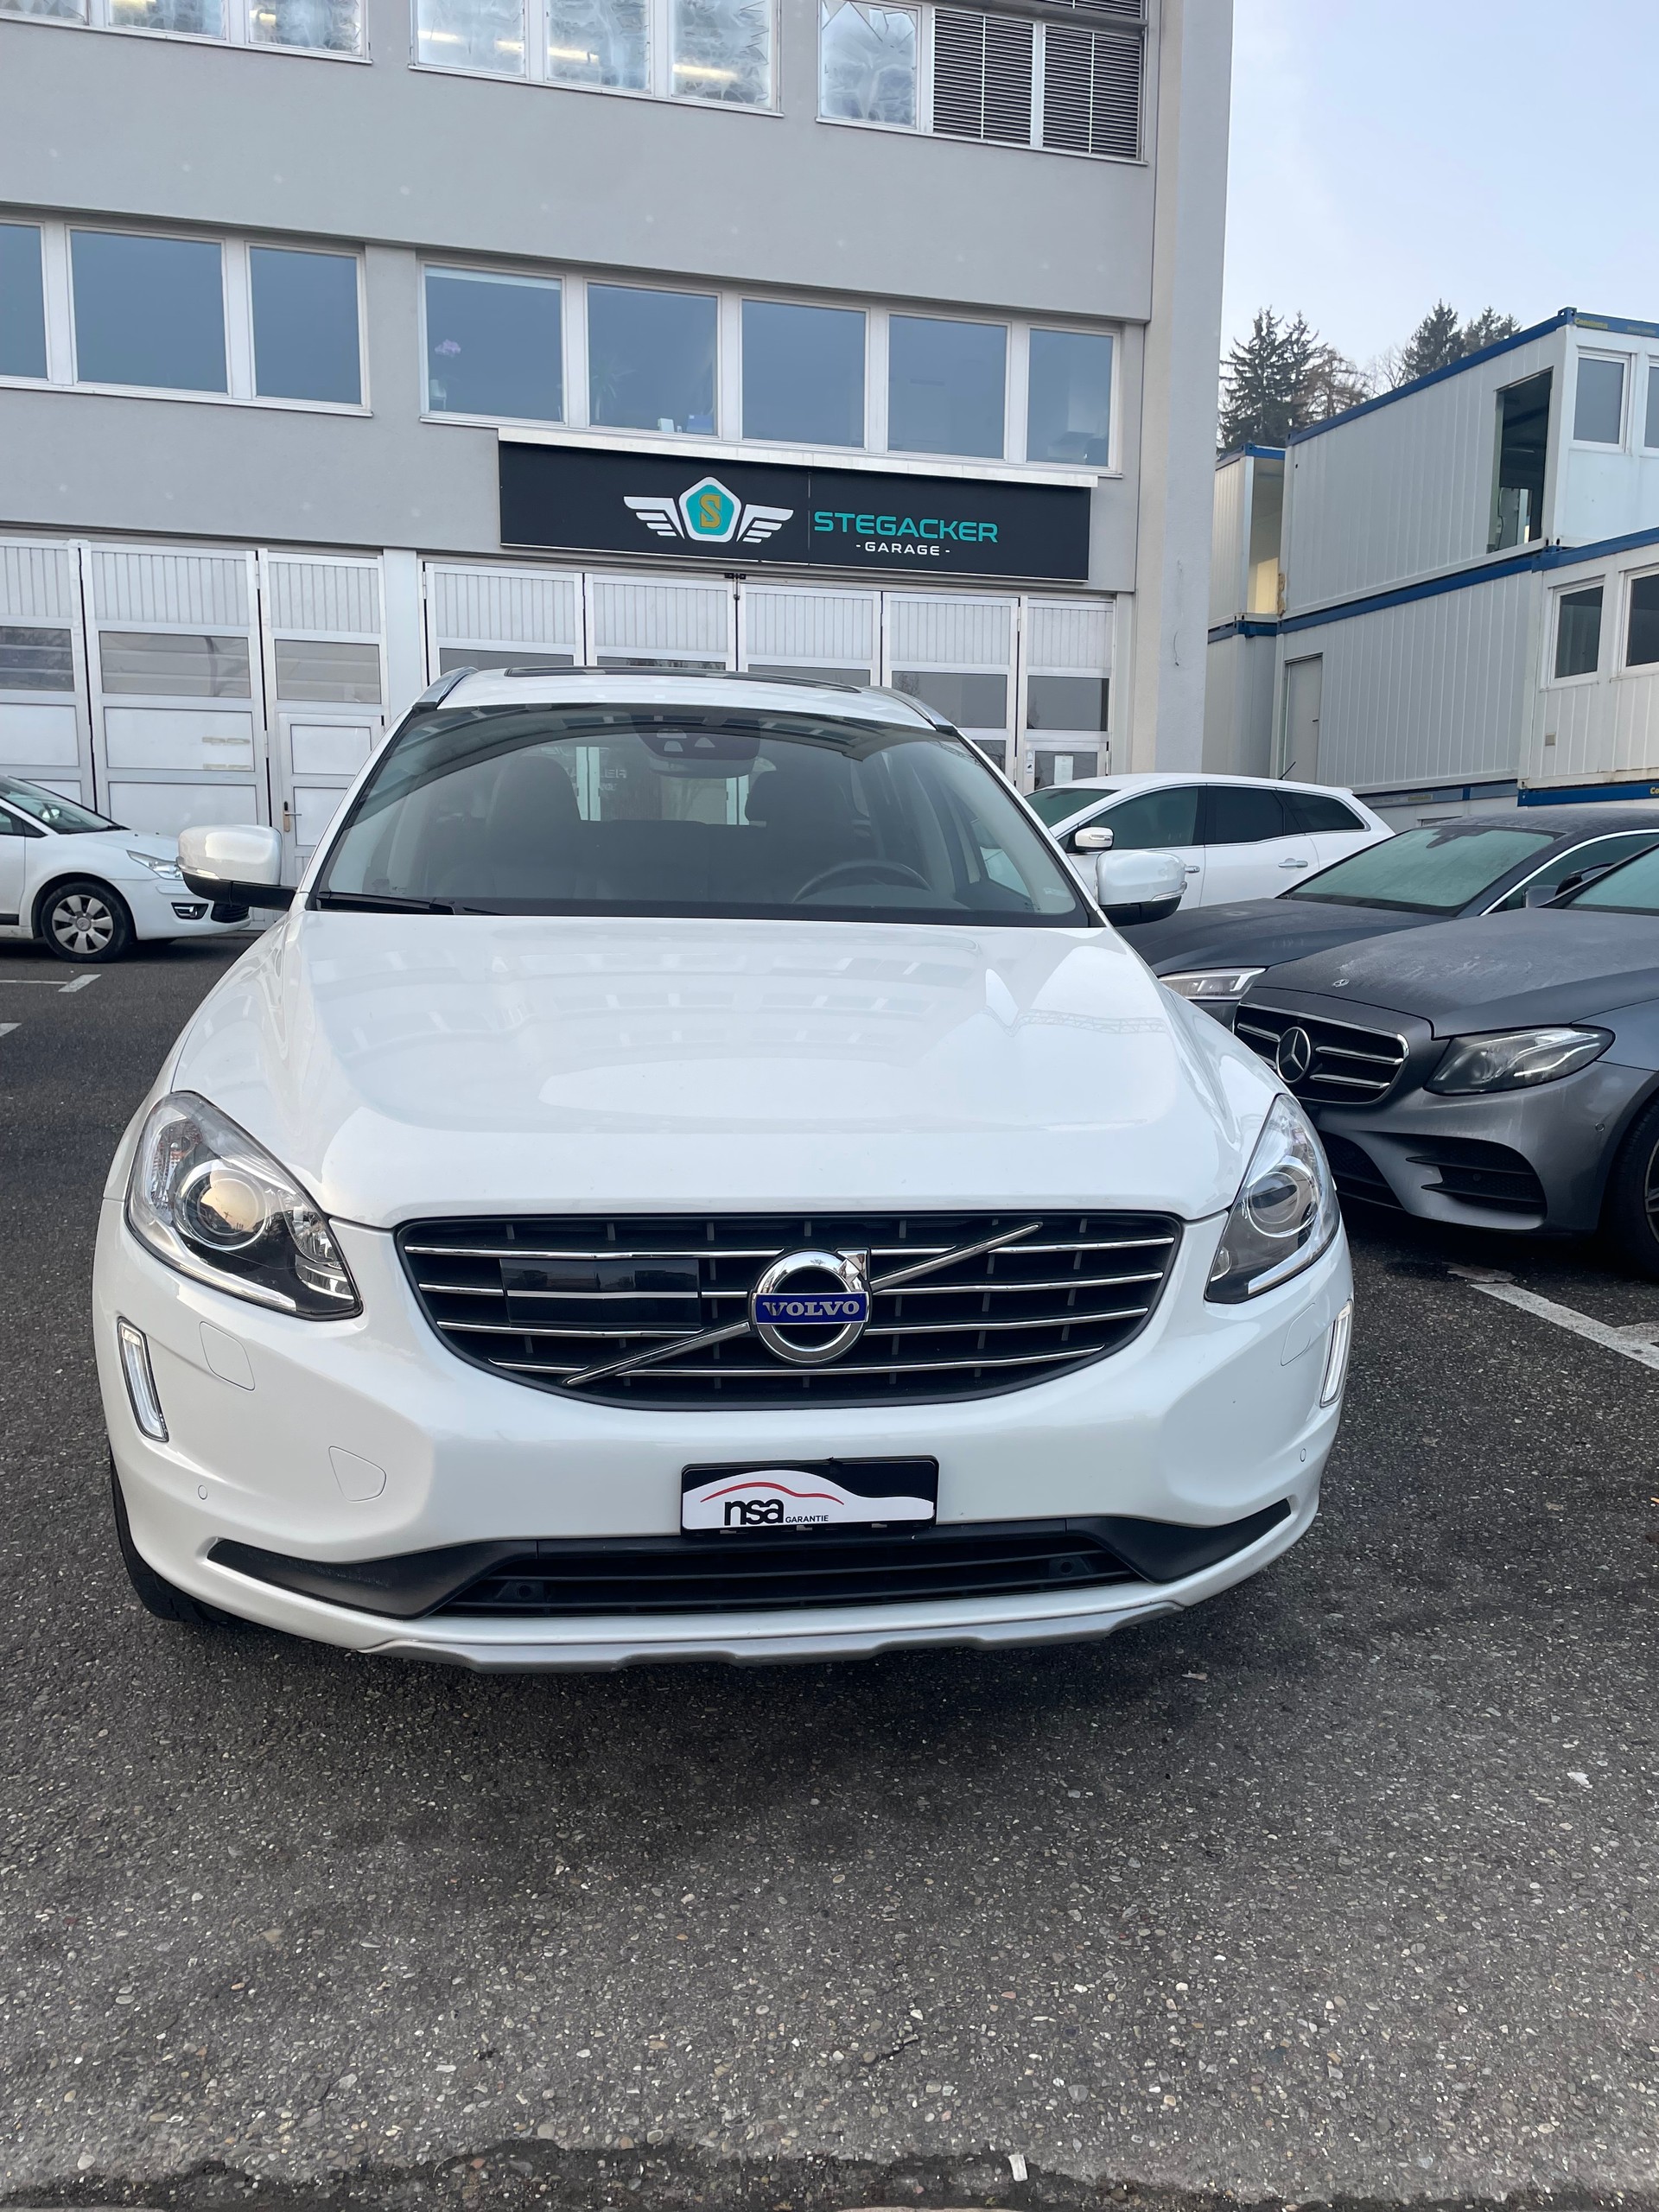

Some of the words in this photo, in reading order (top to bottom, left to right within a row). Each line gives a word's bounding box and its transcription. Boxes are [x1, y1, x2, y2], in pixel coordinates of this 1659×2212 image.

[700, 493, 721, 528] S
[814, 511, 998, 543] STEGACKER
[762, 1300, 860, 1316] VOLVO
[724, 1499, 784, 1526] nsa
[785, 1515, 830, 1523] GARANTIE
